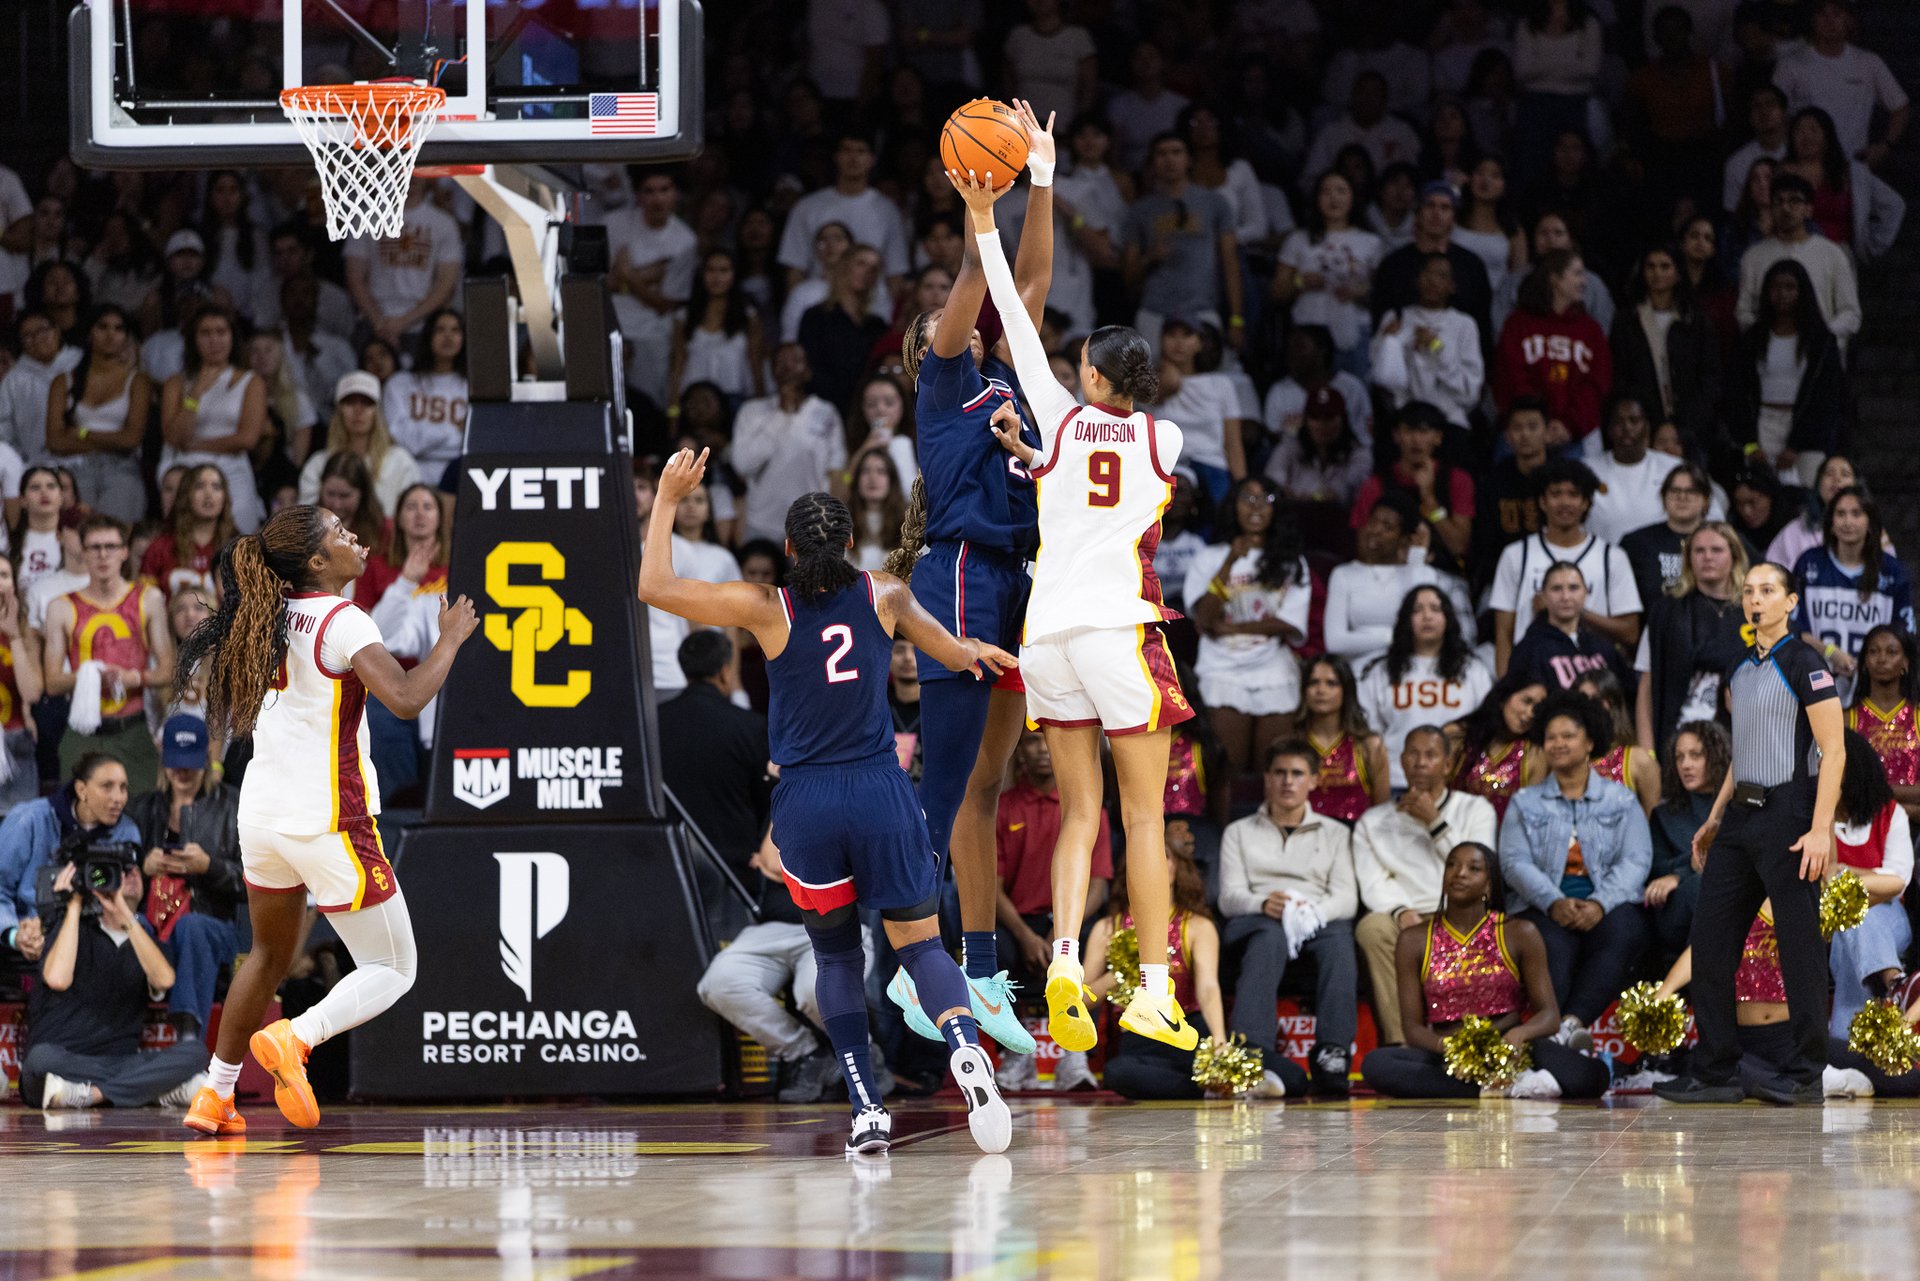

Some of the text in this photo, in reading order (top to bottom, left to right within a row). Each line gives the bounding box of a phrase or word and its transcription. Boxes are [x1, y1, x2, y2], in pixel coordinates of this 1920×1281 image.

[1522, 334, 1593, 373] USC
[410, 393, 465, 429] USC
[1075, 420, 1136, 443] DAVIDSON
[468, 467, 600, 510] YETI
[1088, 450, 1121, 508] 9
[484, 541, 593, 708] SC
[821, 623, 859, 684] 2
[1393, 680, 1462, 709] USC
[517, 747, 623, 779] MUSCLE
[537, 778, 604, 810] MILK
[423, 1010, 638, 1041] PECHANGA
[423, 1043, 640, 1063] RESORT CASINO
